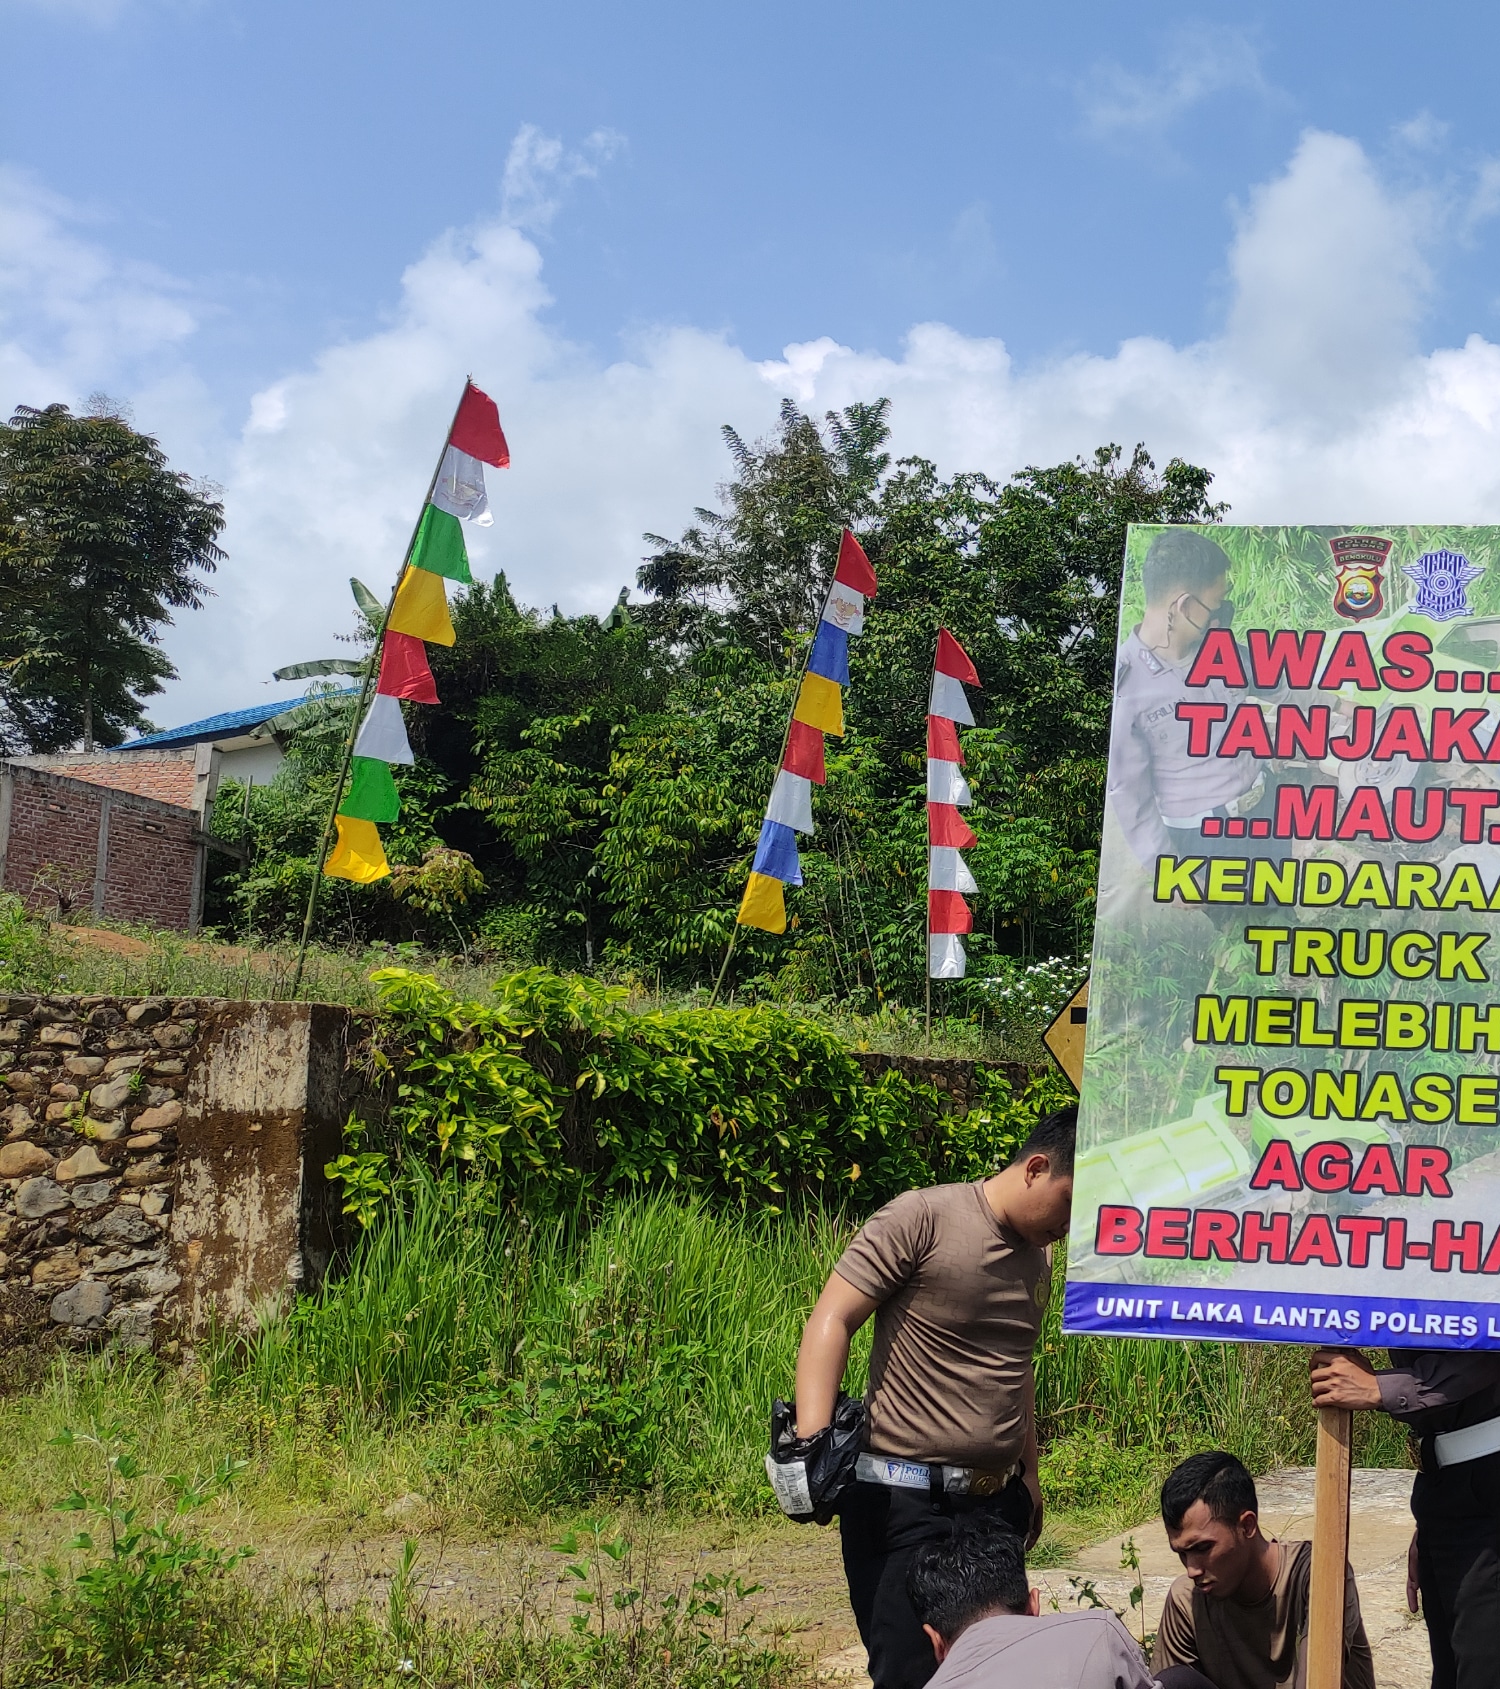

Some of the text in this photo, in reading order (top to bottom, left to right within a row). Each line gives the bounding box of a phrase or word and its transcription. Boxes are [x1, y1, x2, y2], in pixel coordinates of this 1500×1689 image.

[1337, 539, 1385, 547] POLRES
[1339, 554, 1382, 562] BENGKULU
[1246, 928, 1489, 980] TRUCK
[1217, 1068, 1500, 1125] TONASE
[1250, 1140, 1452, 1197] AGAR
[1096, 1297, 1163, 1319] UNIT
[1171, 1301, 1244, 1324] LAKA
[1253, 1305, 1361, 1330] LANTAS
[1370, 1311, 1478, 1337] POLRES
